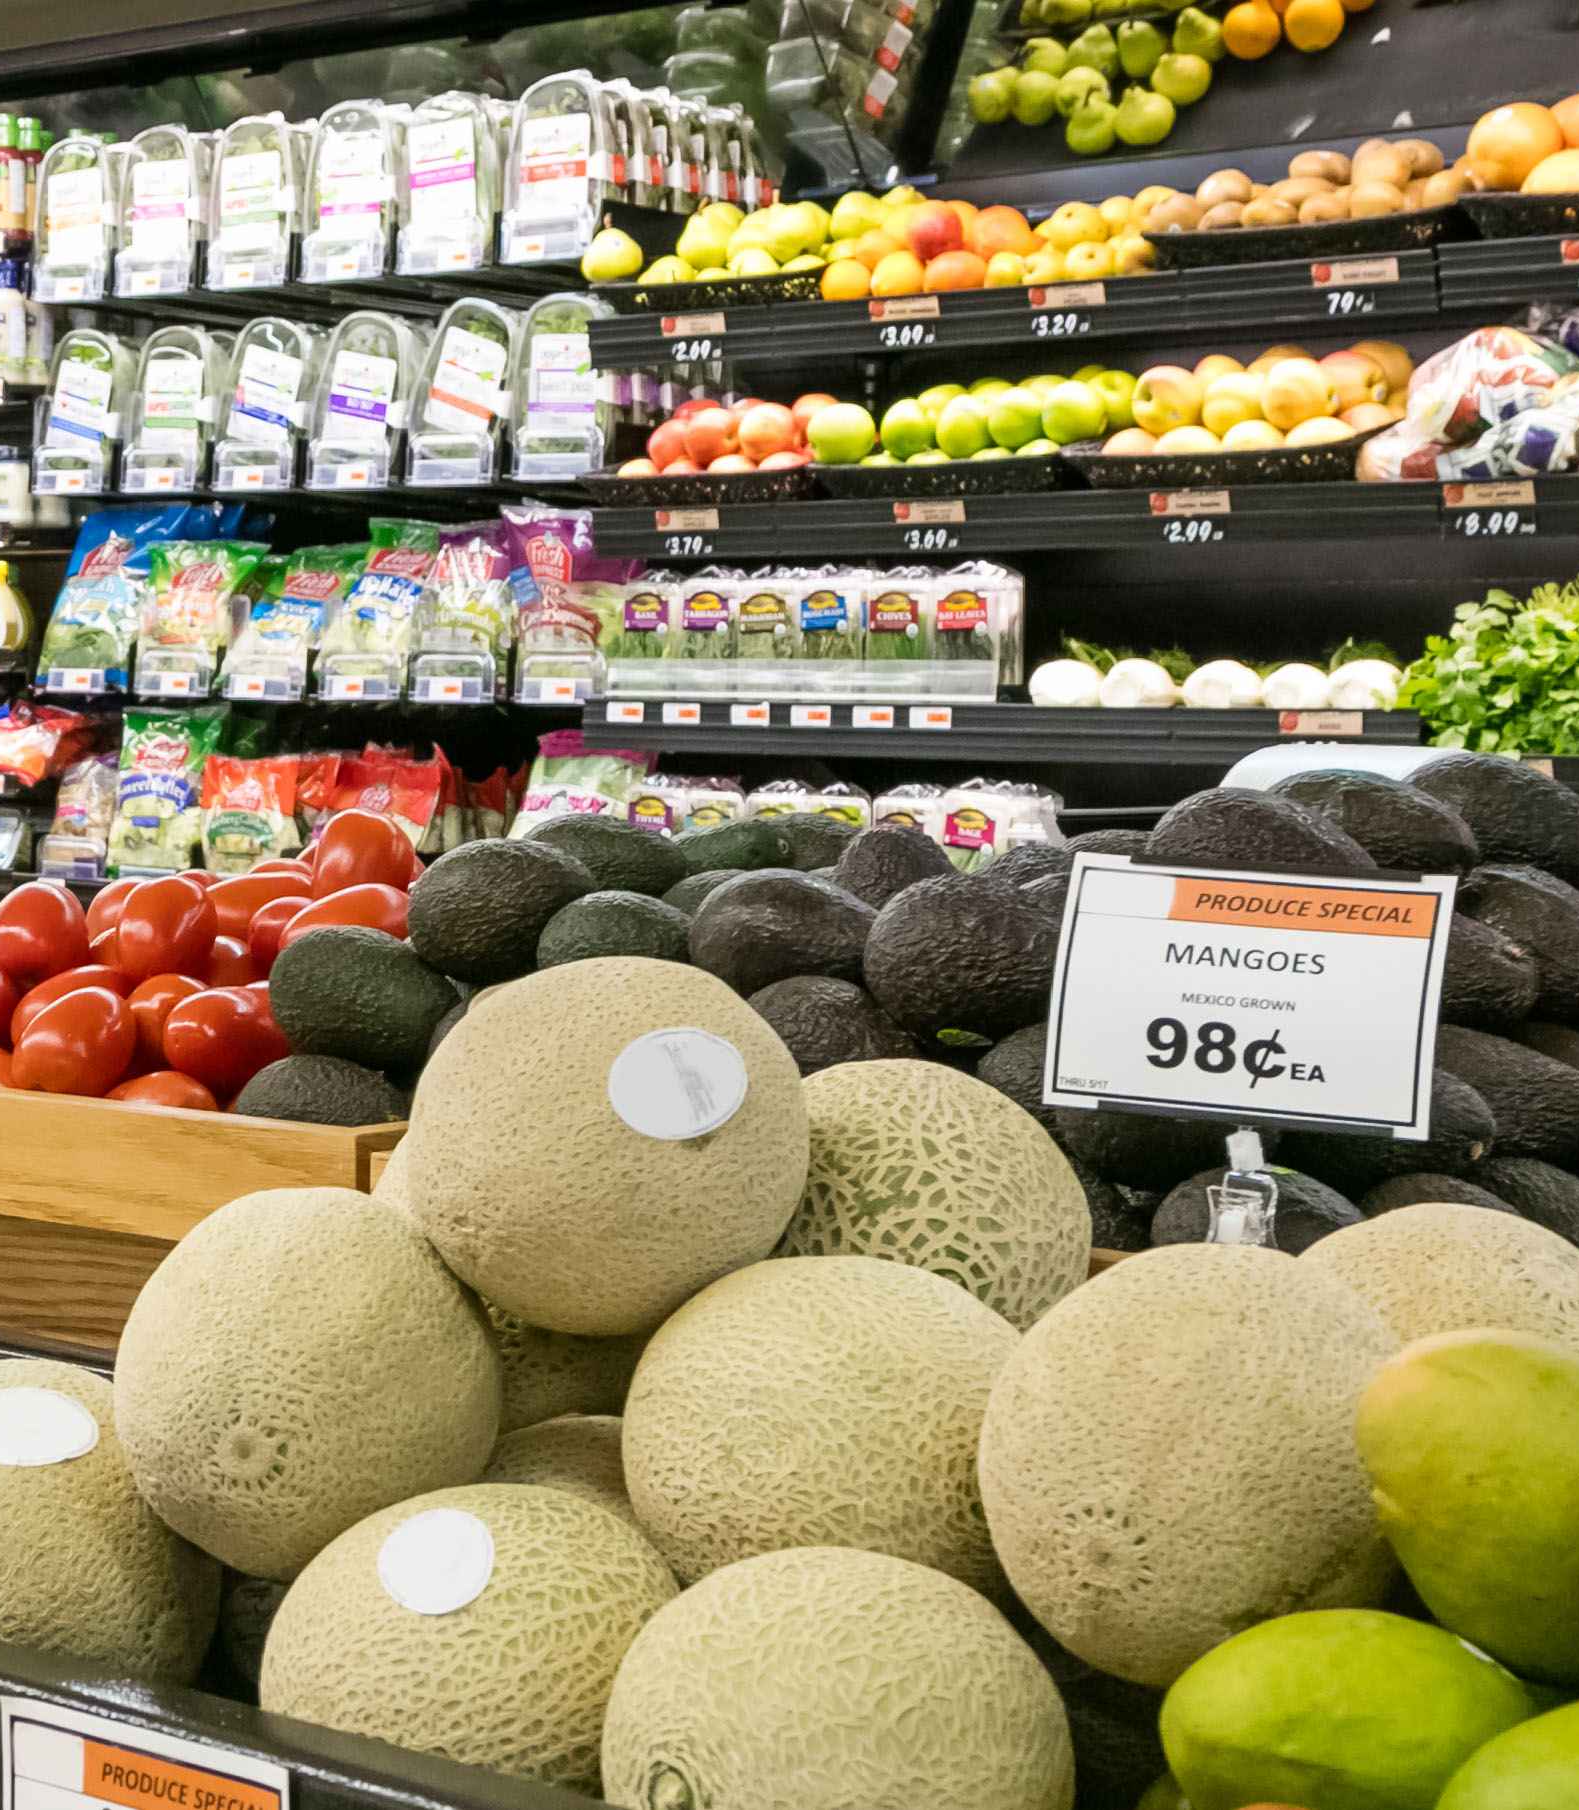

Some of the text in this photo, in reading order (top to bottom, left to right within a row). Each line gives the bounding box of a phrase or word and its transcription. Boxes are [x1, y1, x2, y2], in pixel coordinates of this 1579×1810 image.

[1194, 892, 1414, 925] PRODUCE SPECIAL
[1164, 942, 1327, 976] MANGOES
[1181, 991, 1297, 1013] MEXICO GROWN
[1145, 1015, 1327, 1089] 98¢ EA
[101, 1762, 188, 1806] PRODUCE
